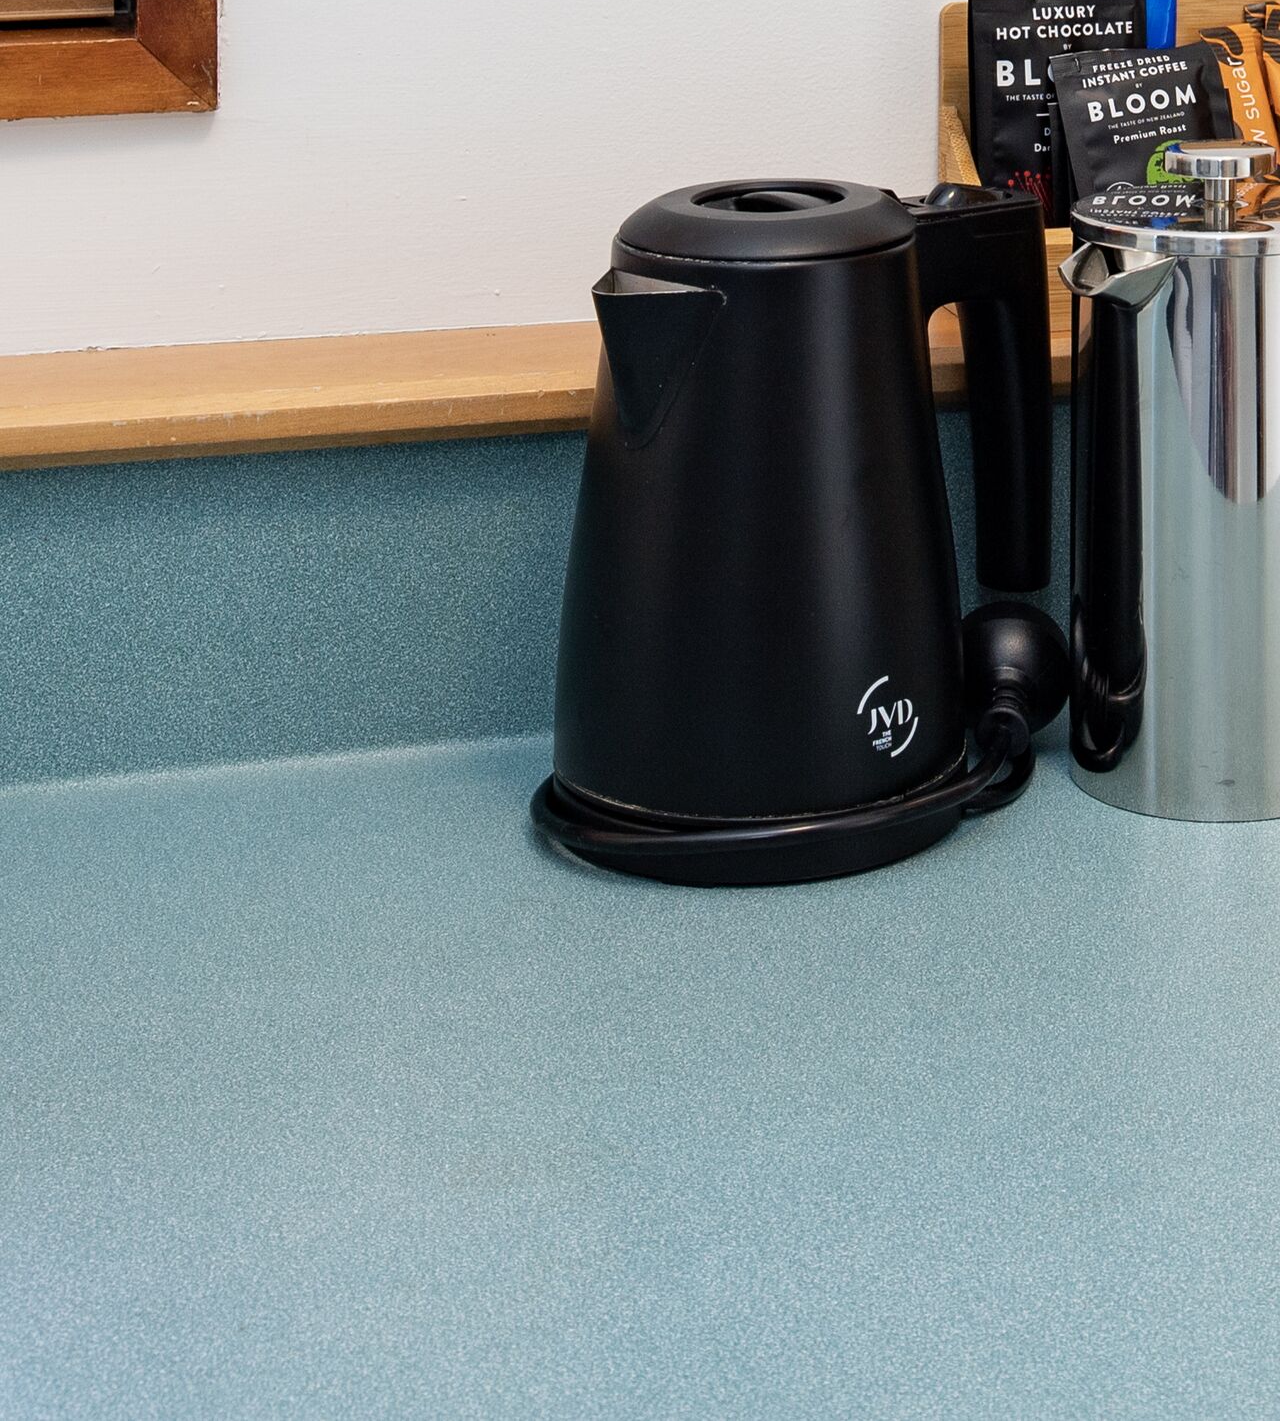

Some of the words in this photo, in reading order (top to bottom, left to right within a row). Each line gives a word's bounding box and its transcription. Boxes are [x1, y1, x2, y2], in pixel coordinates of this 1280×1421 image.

[1032, 5, 1096, 21] LUXURY
[996, 26, 1031, 41] HOT
[1037, 21, 1133, 39] CHOCOLATE
[1092, 60, 1134, 73] FREEZE
[1136, 55, 1170, 66] DRIED
[1082, 70, 1136, 89] INSTANT
[1140, 61, 1188, 77] COFFEE
[1087, 84, 1197, 122] BLOOM
[1160, 111, 1185, 120] ZEALAND
[1113, 130, 1157, 144] Premium
[1160, 124, 1187, 136] Roast
[867, 698, 913, 735] JVD
